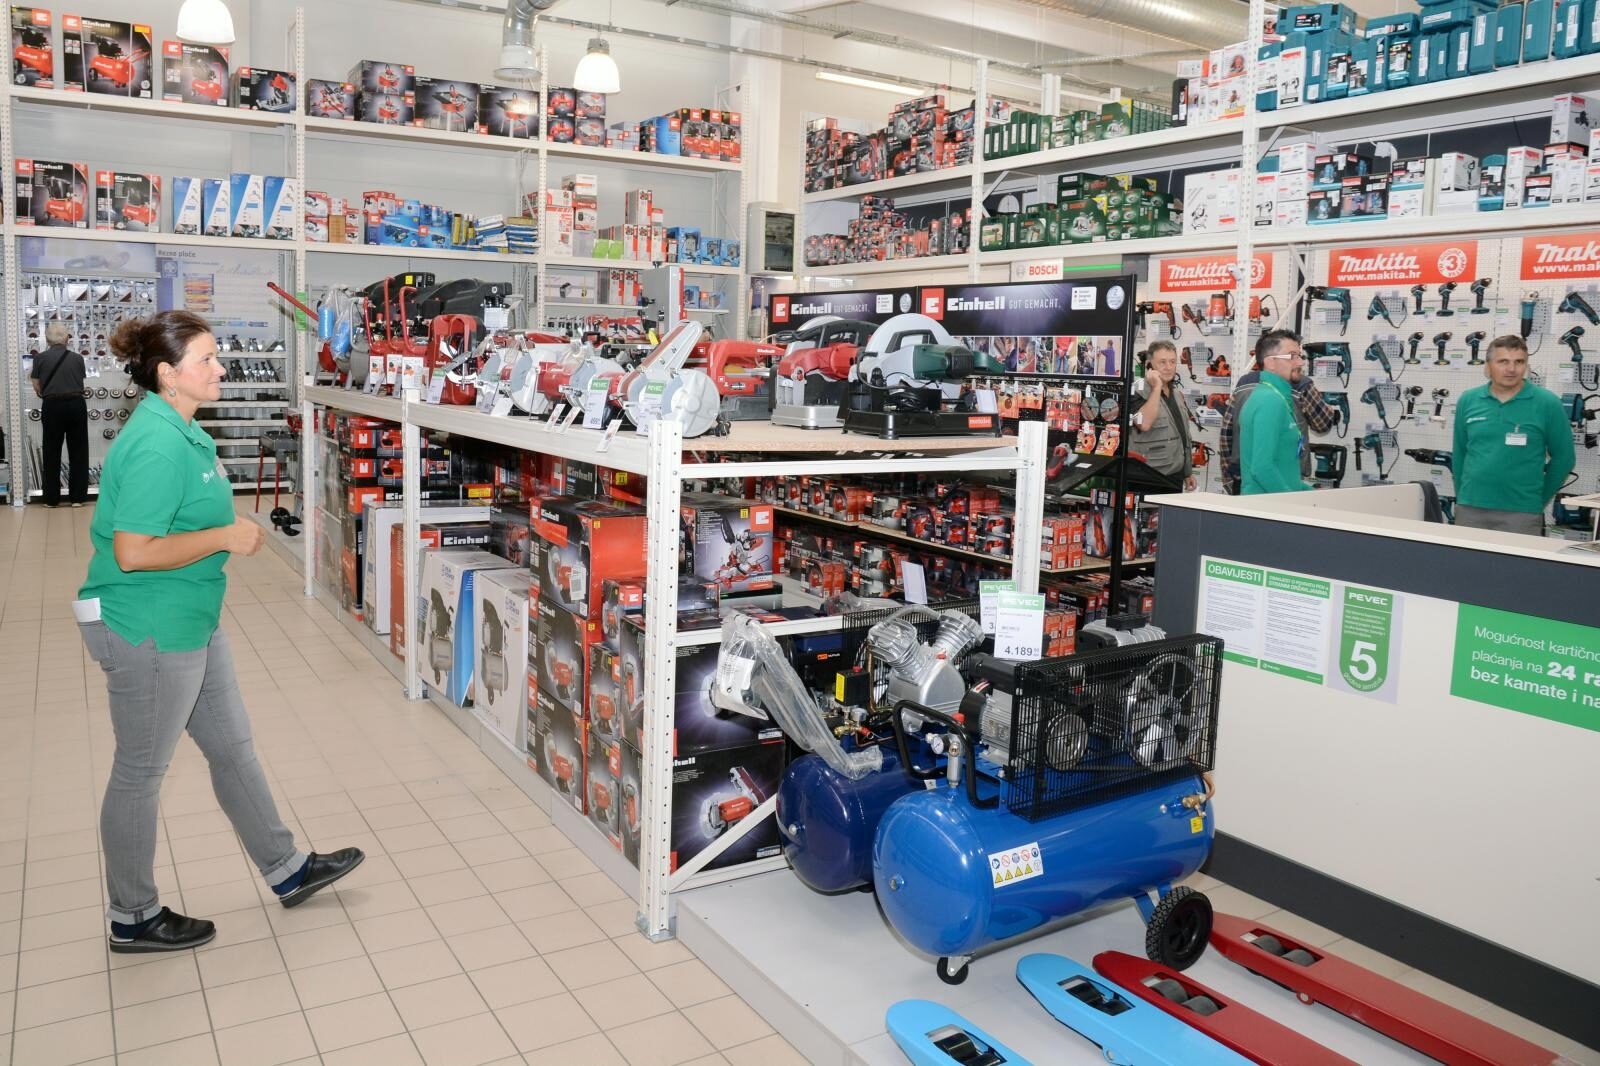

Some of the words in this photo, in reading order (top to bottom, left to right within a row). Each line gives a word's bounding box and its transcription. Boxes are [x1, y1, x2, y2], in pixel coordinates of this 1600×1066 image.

[1029, 265, 1058, 275] BOSCH
[1337, 270, 1422, 282] www.makita.hr
[1167, 278, 1232, 288] www.makita.hr
[791, 303, 832, 315] Einhell
[947, 295, 1005, 311] Einhell
[1008, 299, 1023, 309] GUT
[1208, 564, 1261, 582] OBAVIJESTI
[1349, 592, 1388, 606] PEVEC
[1474, 626, 1545, 651] Mogućnost
[1004, 645, 1033, 656] 4.189
[1349, 640, 1377, 681] 5
[1471, 650, 1524, 670] plaćanja
[1526, 662, 1543, 674] na
[1547, 661, 1576, 681] 24
[1470, 666, 1500, 685] bez
[1504, 674, 1568, 700] kamate
[1572, 689, 1578, 703] i
